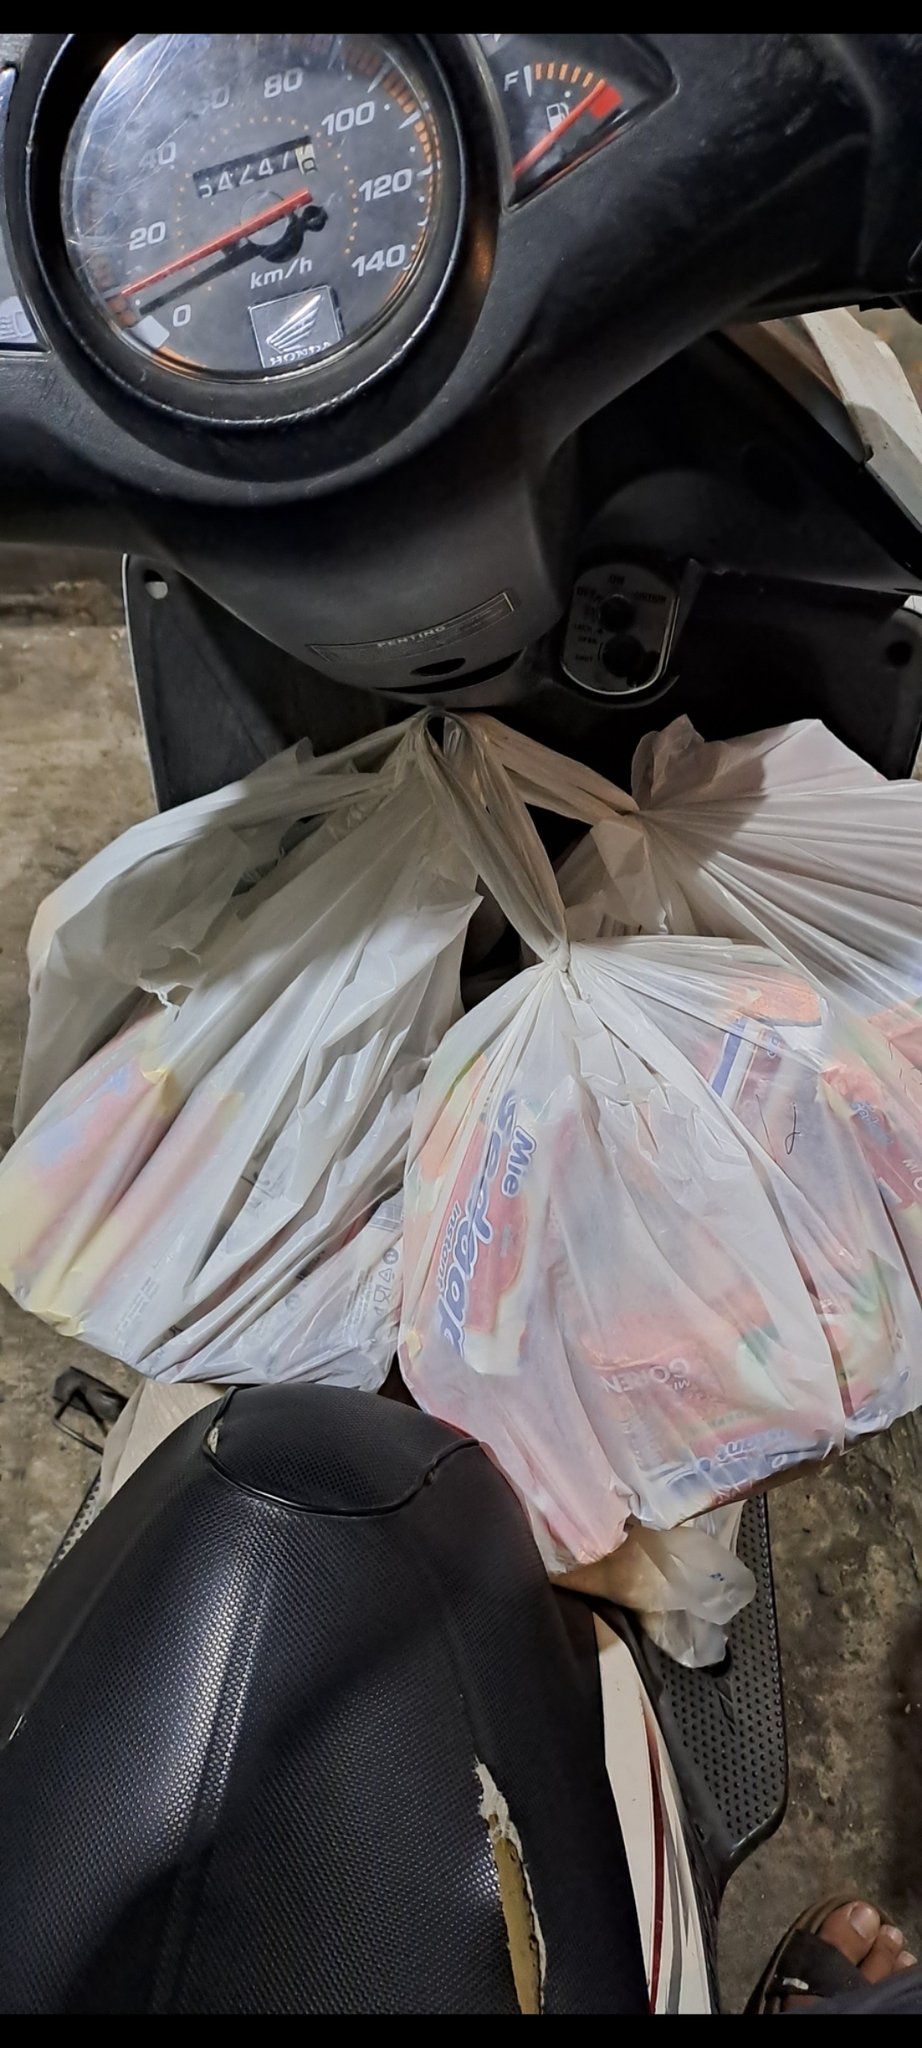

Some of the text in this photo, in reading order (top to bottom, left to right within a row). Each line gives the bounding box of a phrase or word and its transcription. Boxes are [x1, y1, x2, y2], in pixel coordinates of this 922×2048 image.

[264, 68, 303, 98] 80
[504, 70, 519, 91] F
[321, 101, 375, 135] 100
[139, 142, 176, 168] 40
[359, 169, 412, 201] 120
[129, 221, 166, 251] 20
[250, 257, 313, 289] km/h
[352, 244, 406, 277] 140
[172, 304, 191, 327] 0
[377, 626, 446, 648] PENTING
[502, 1125, 536, 1197] Mie
